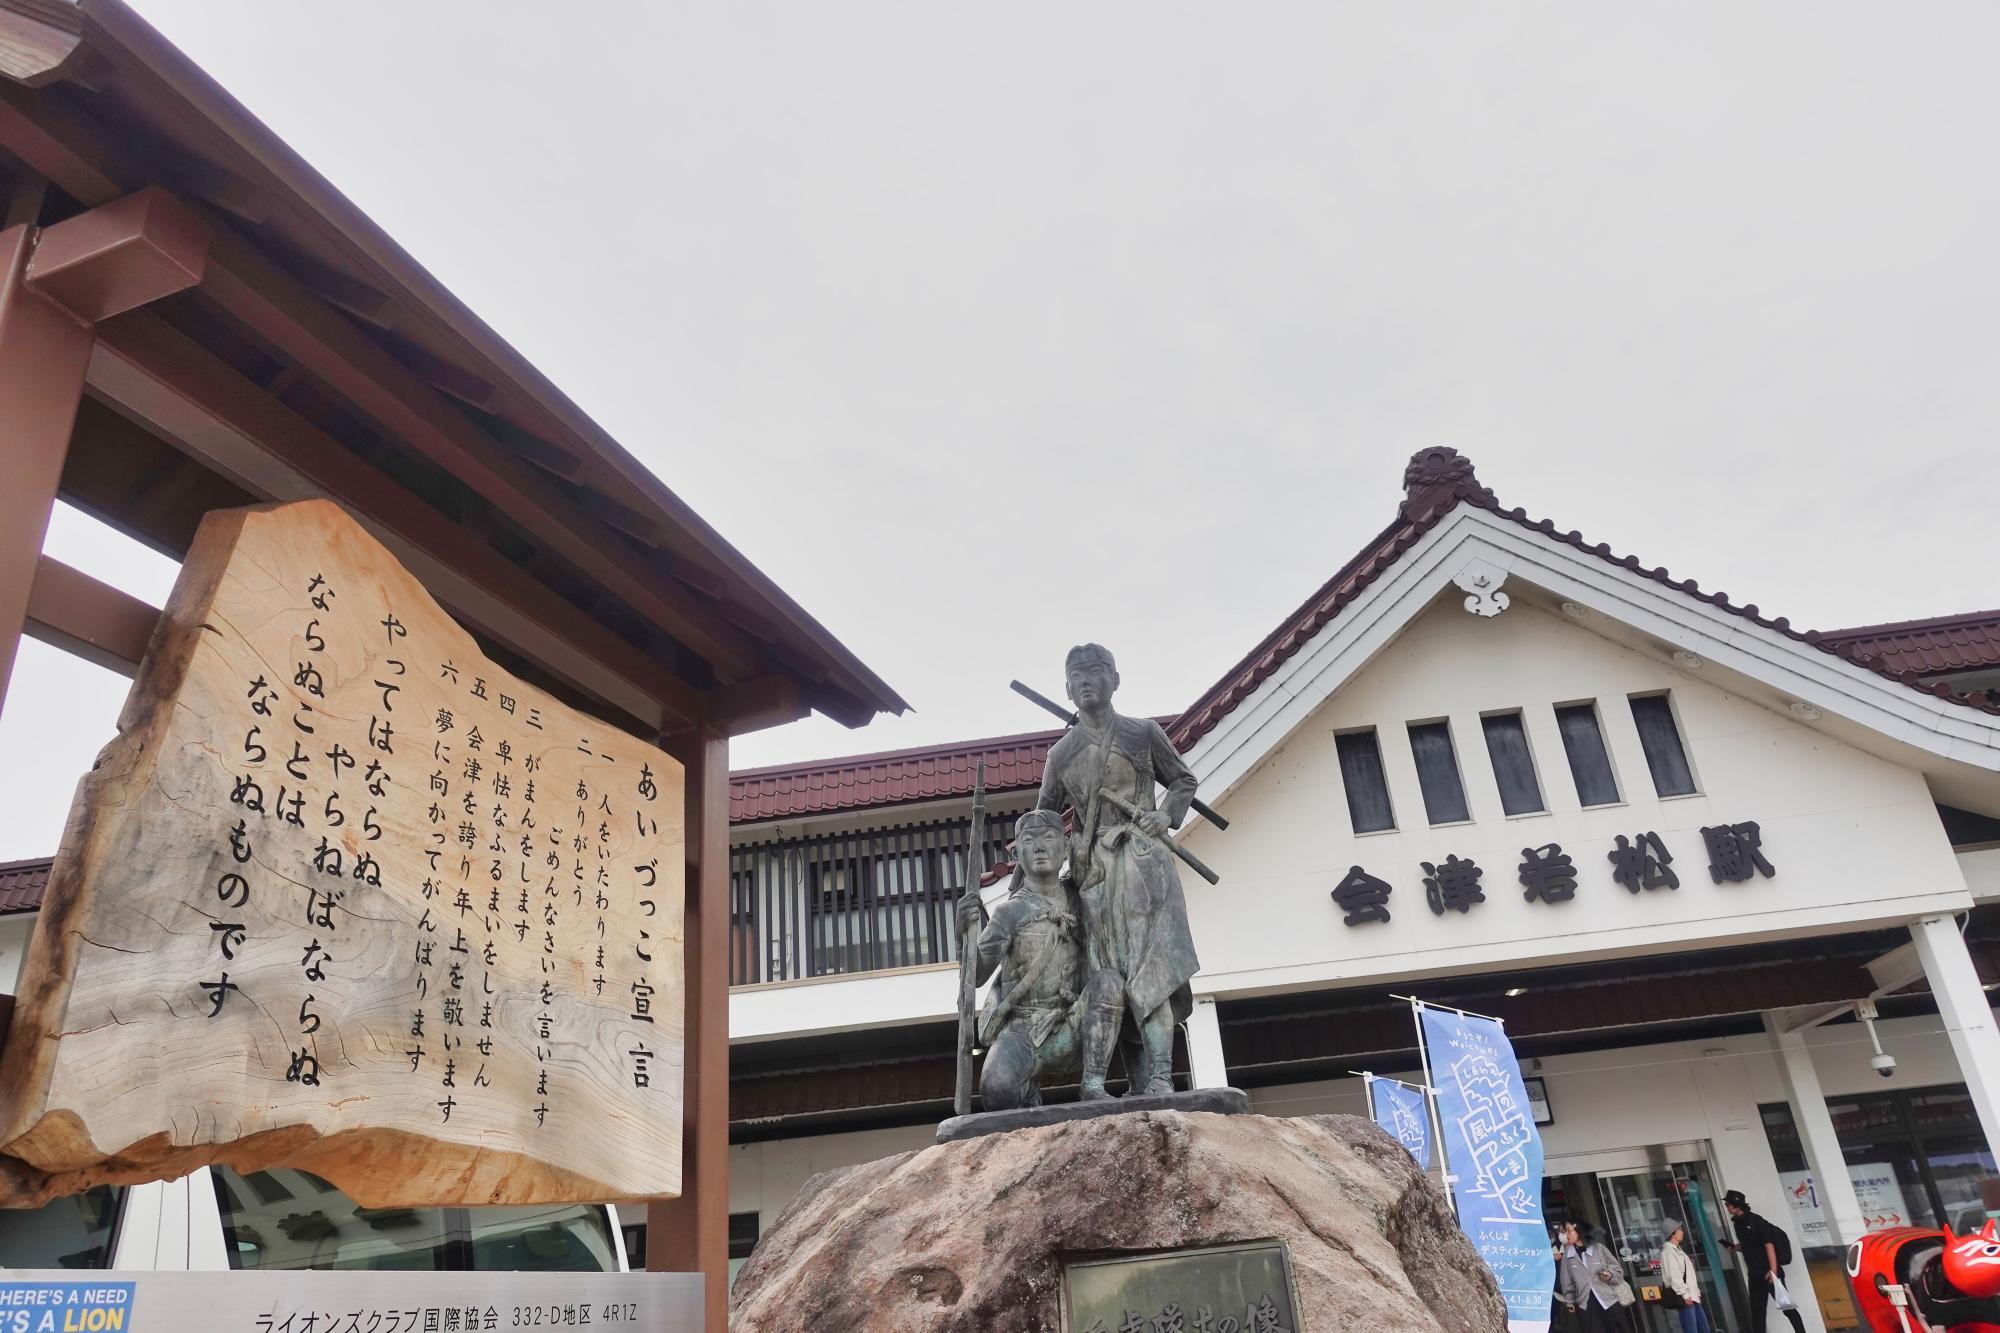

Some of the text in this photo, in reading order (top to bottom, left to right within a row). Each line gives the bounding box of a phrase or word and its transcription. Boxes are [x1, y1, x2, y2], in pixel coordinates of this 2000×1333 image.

[276, 573, 336, 828] ならぬことは
[353, 613, 407, 887] やってはならぬ
[199, 675, 279, 1018] ならぬものです
[286, 743, 355, 1087] やらねばならぬ
[406, 707, 454, 1072] 夢に向かってがんばります
[437, 725, 485, 1124] 会津を誇り年上を敬います
[473, 740, 513, 1088] 卑怯なふるまいをしません
[514, 753, 541, 942] がまんをします
[573, 779, 588, 906] ありがとう
[592, 794, 613, 996] 人をいたわります
[629, 763, 659, 1088] あいづっこ宣言
[1331, 820, 1776, 927] 会津若松駅
[533, 826, 563, 1128] ごめんなさいを言います
[0, 1289, 128, 1306] HERE'S A NEED
[36, 1309, 55, 1333] A
[63, 1307, 125, 1332] LION
[255, 1303, 638, 1333] ライオンズクラブ国際協会 332-D地区 4R1Z
[1479, 1230, 1510, 1241] ふくしま
[1480, 1244, 1543, 1257] デスティネーション
